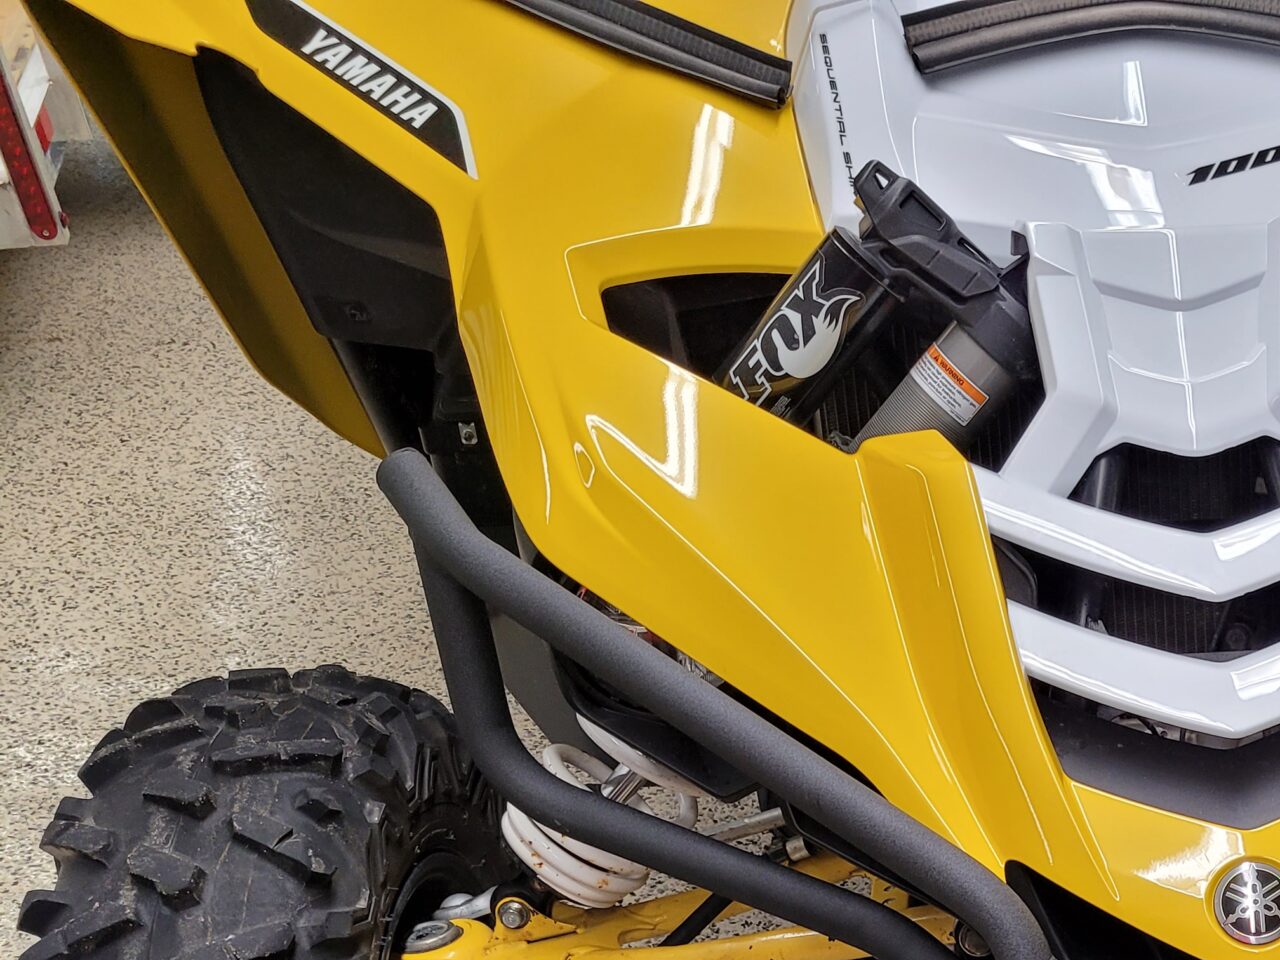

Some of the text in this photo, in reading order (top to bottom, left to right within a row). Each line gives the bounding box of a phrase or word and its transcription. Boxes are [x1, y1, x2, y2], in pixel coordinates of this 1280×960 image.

[300, 28, 439, 129] YAMAHA
[819, 33, 847, 146] SEQUENTIAL
[729, 260, 846, 406] FOX
[939, 360, 965, 386] WARNING
